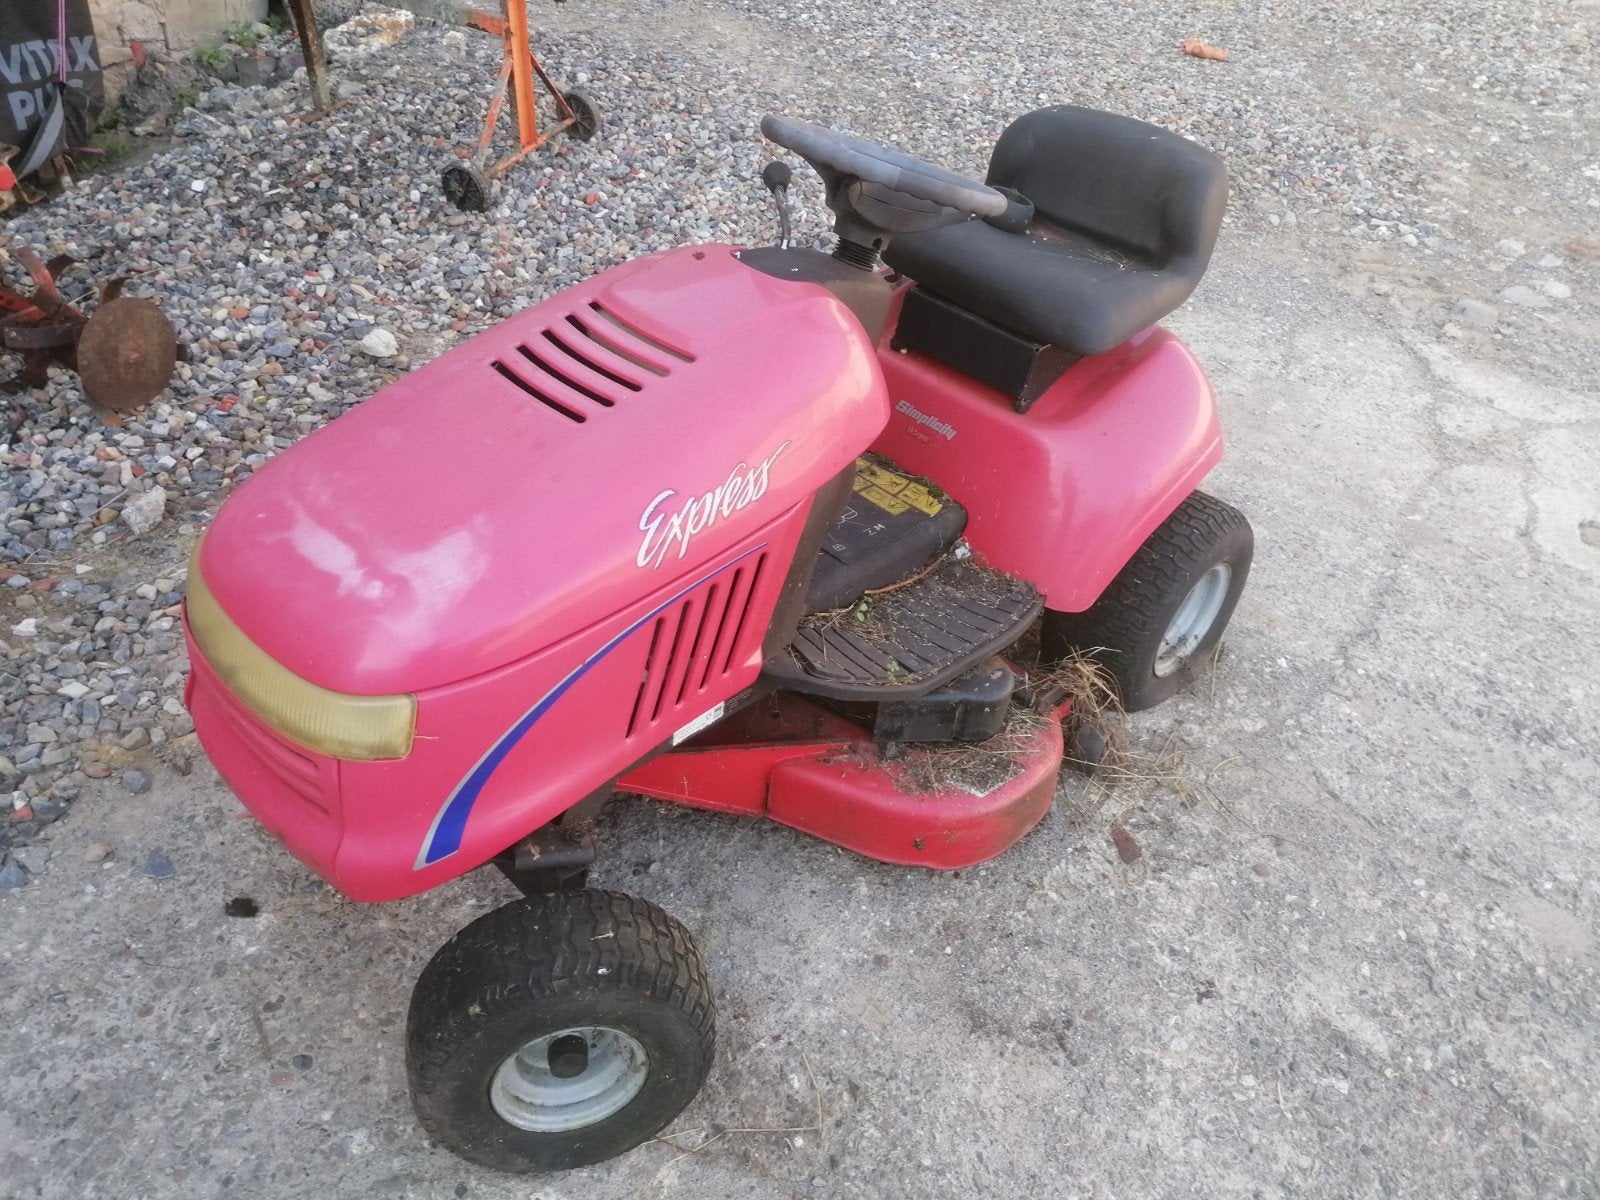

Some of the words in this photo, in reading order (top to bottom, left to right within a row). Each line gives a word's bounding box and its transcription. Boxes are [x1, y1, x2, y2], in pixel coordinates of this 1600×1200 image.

[0, 35, 100, 84] VITAX
[895, 400, 957, 440] Simplicity
[636, 440, 791, 570] Express
